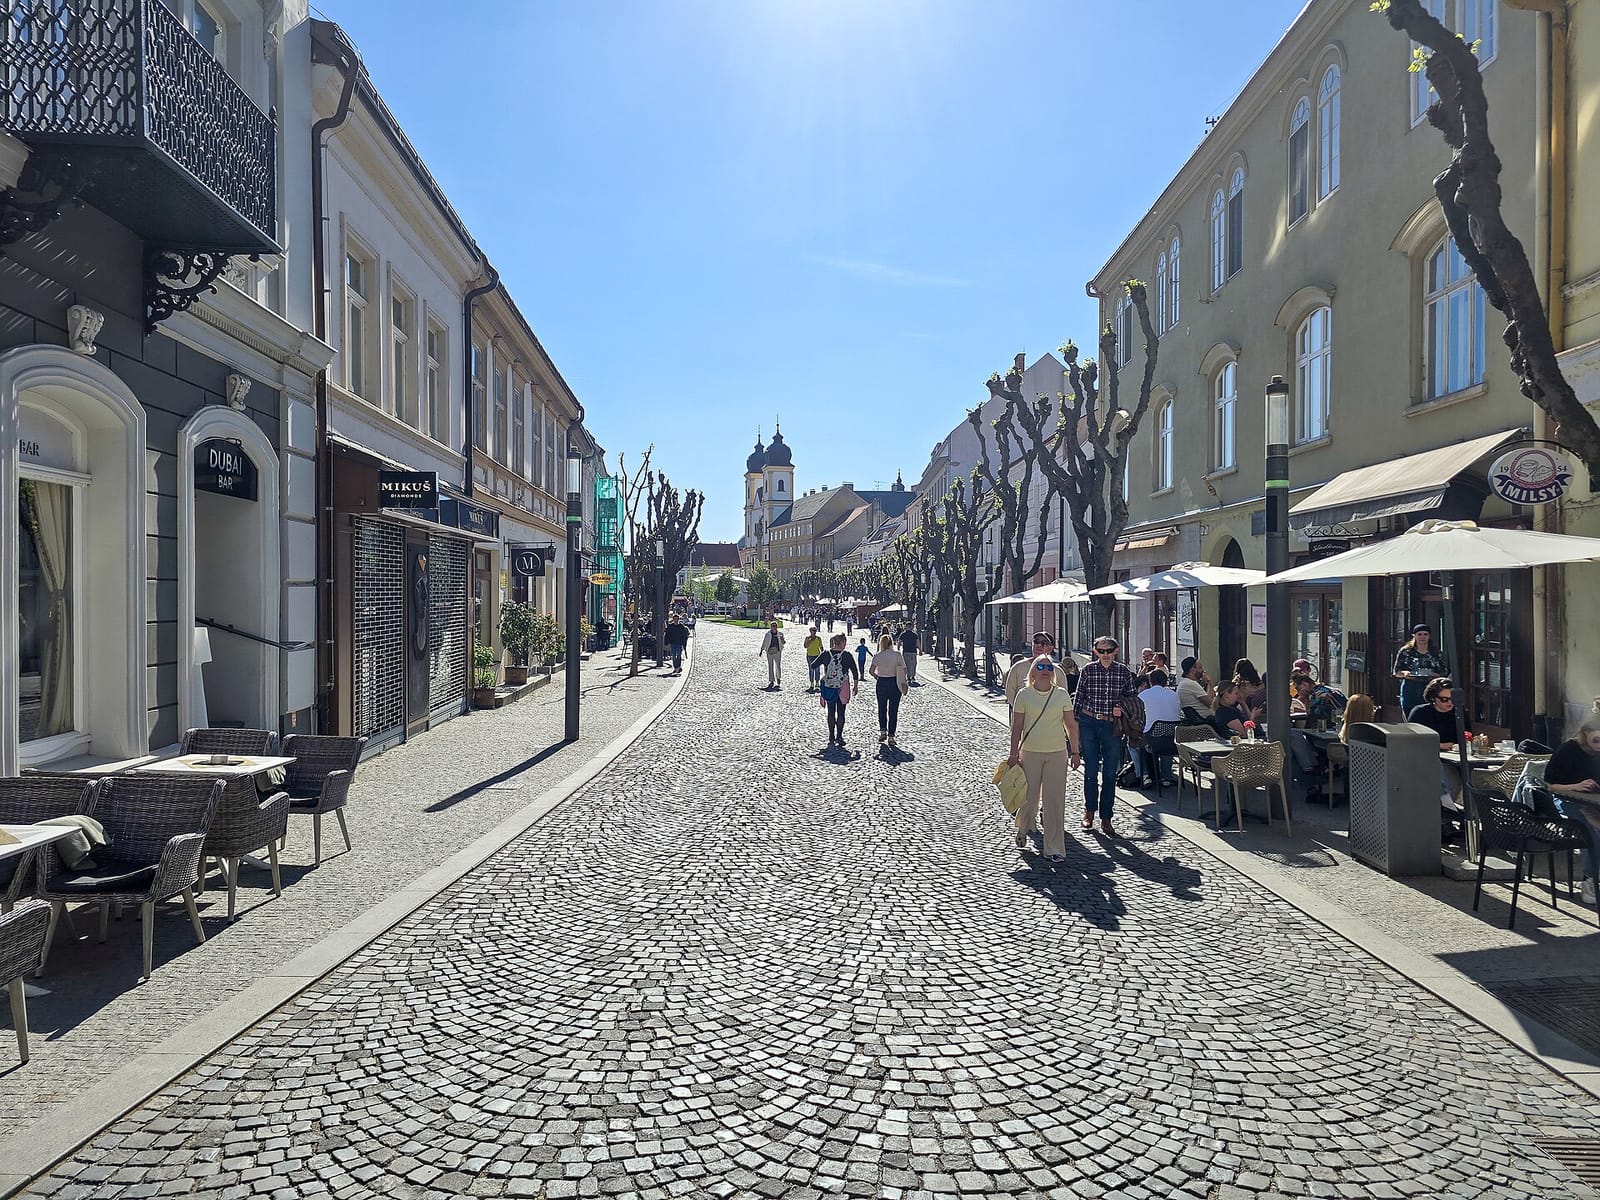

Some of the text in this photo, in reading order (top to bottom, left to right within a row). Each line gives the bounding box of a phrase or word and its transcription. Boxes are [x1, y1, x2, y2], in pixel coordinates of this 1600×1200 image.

[19, 439, 40, 457] BAR
[210, 448, 242, 476] DUBAI
[1500, 465, 1510, 473] 19
[218, 474, 233, 490] BAR
[381, 480, 431, 492] MIKUŠ
[1504, 484, 1558, 502] MILSY
[522, 556, 535, 570] M
